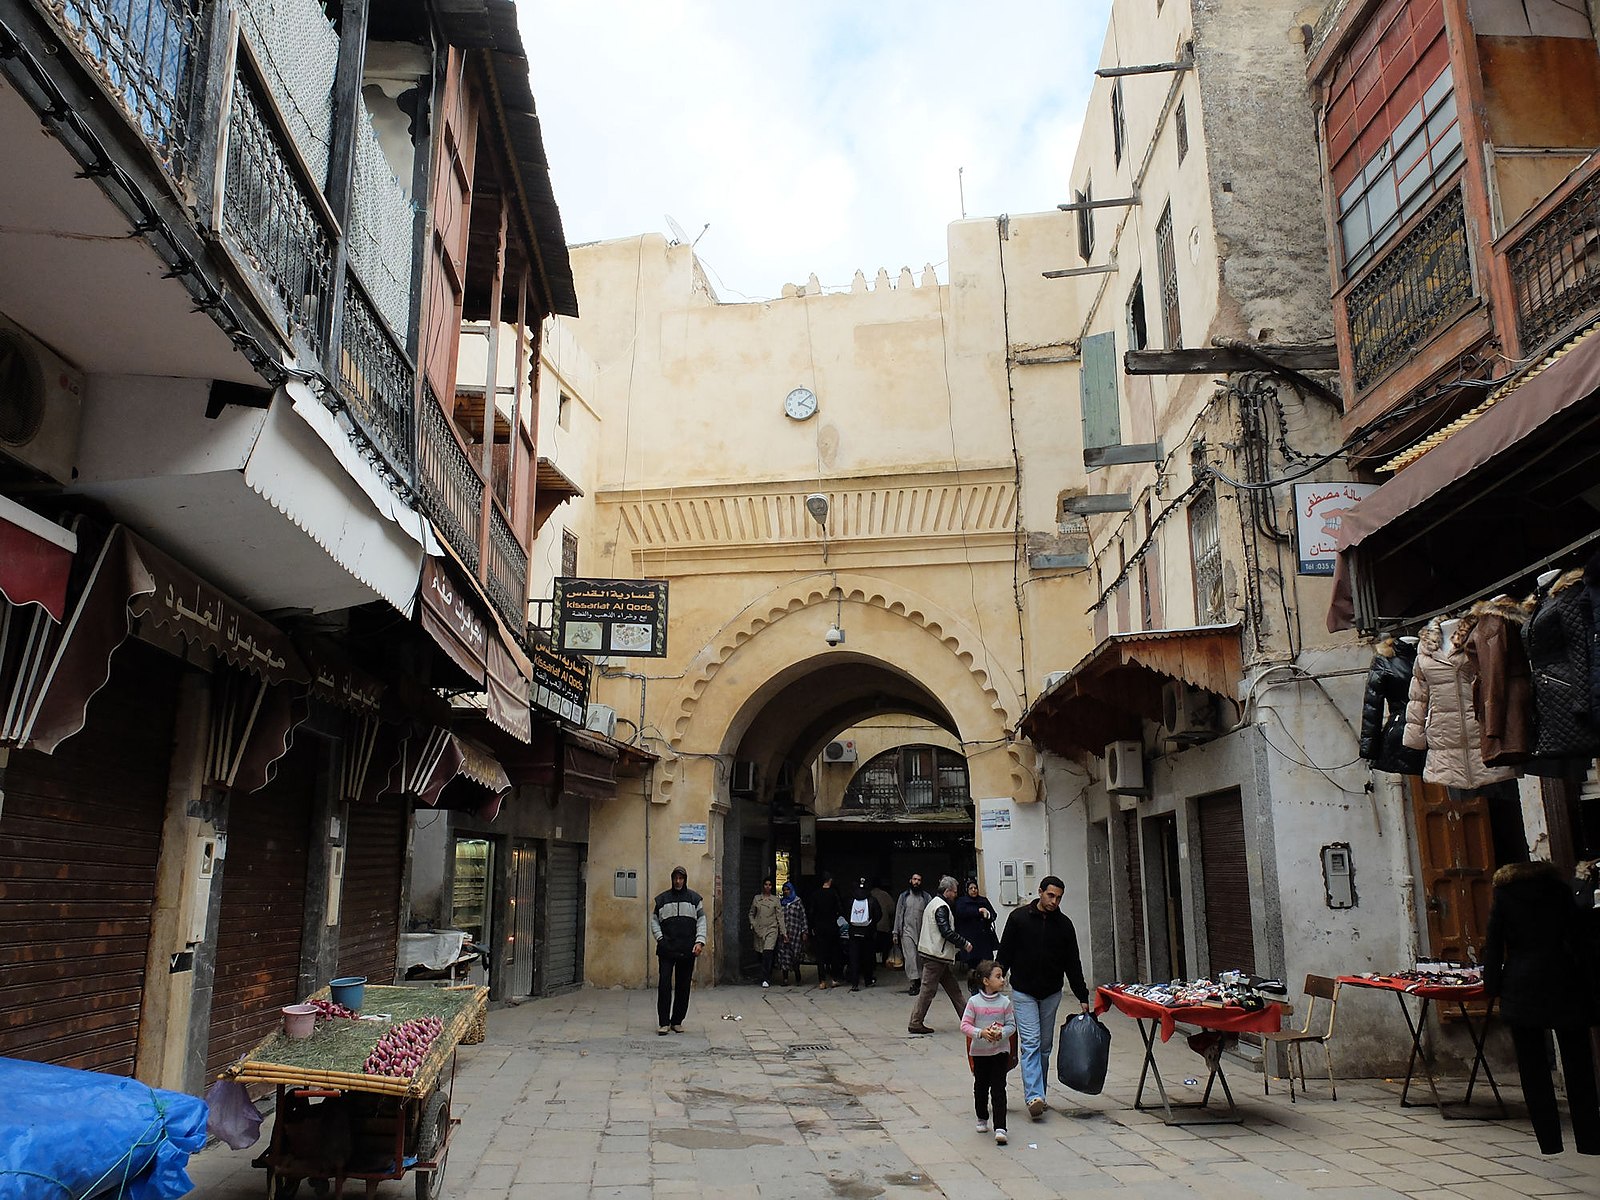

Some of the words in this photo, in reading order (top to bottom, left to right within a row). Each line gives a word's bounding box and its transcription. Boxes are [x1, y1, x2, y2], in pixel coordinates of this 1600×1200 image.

[1304, 491, 1340, 518] مصطفى
[565, 590, 609, 599] القدس
[610, 590, 655, 600] قسارية
[164, 583, 225, 632] الخلود
[626, 603, 654, 611] Qods
[594, 611, 616, 619] الذهب
[226, 615, 287, 670] مجوهرات
